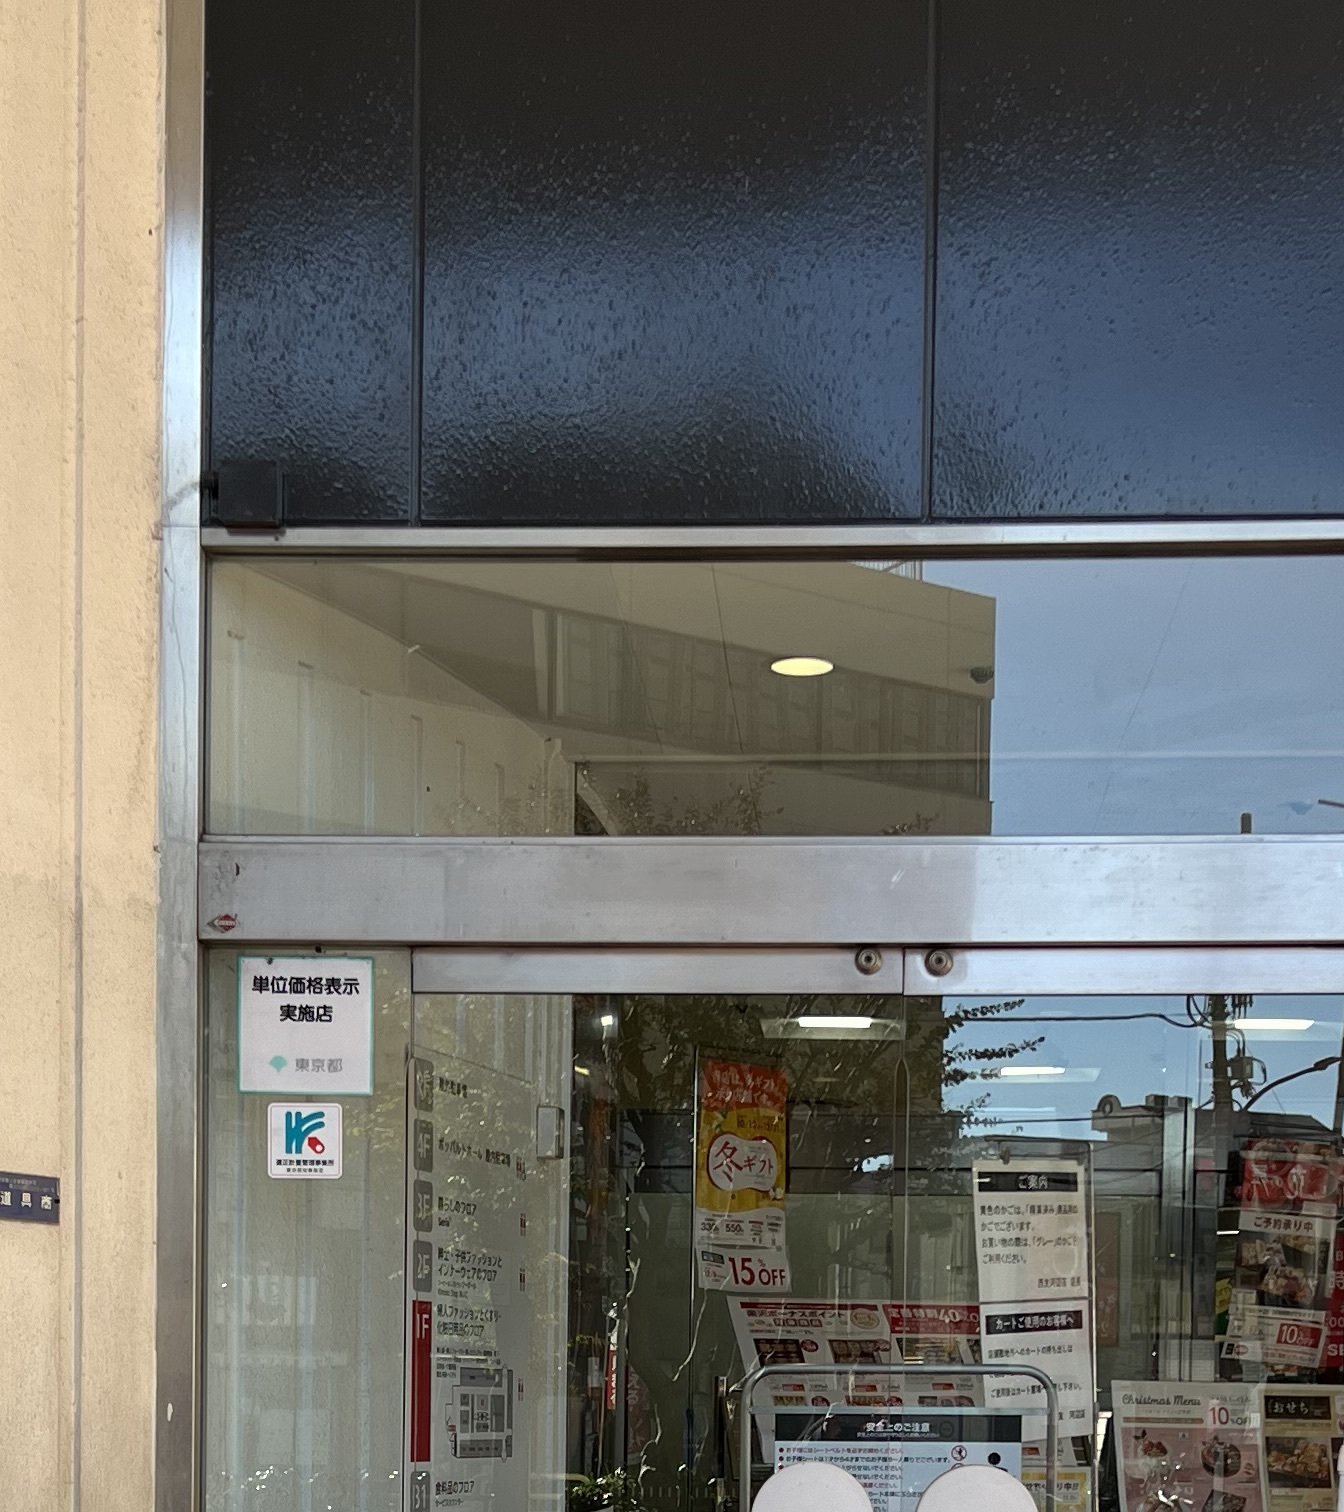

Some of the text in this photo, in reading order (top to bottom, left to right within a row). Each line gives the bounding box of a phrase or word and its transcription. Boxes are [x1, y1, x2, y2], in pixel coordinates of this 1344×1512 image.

[252, 975, 360, 996] 単位価格表示
[279, 1004, 333, 1023] 実施店
[294, 1057, 343, 1074] 東京都
